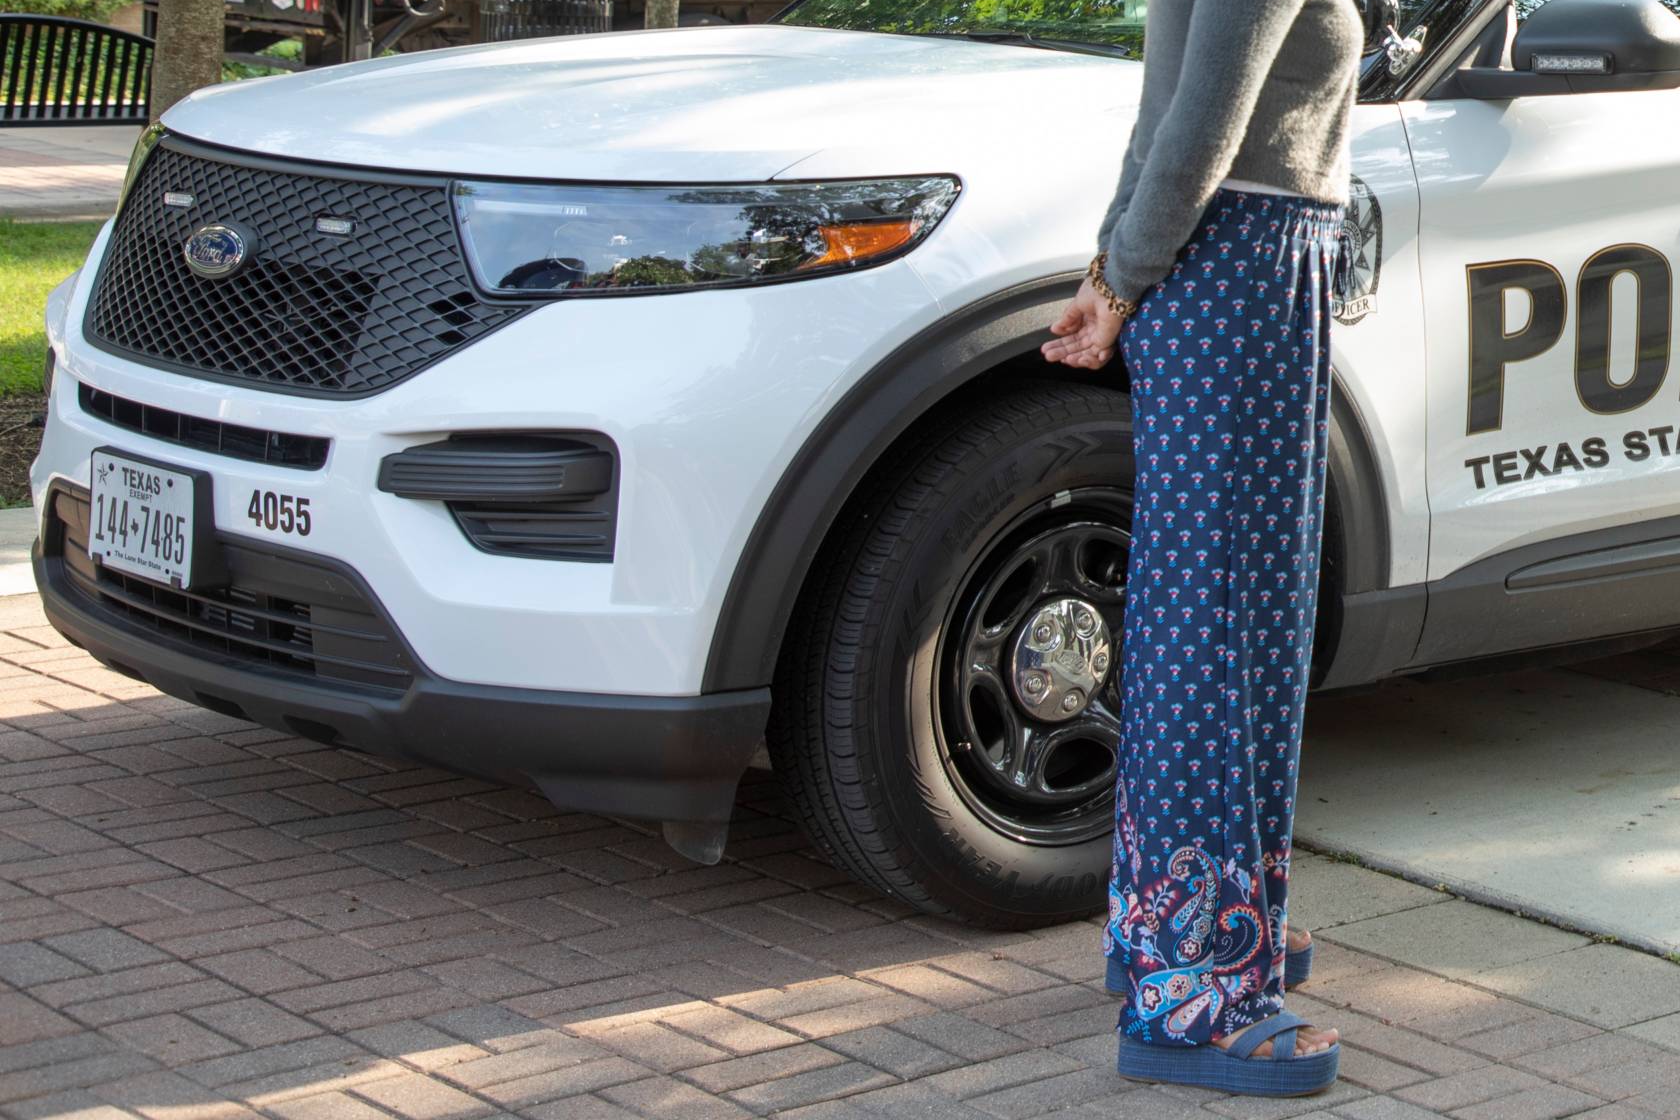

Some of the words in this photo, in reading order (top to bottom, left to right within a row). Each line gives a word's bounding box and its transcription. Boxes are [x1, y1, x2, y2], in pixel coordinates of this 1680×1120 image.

[121, 466, 161, 496] TEXAS
[1464, 436, 1610, 490] TEXAS
[129, 488, 153, 503] EXEMPT
[247, 489, 312, 537] 4055
[95, 493, 129, 549] 144
[140, 504, 186, 566] 7485
